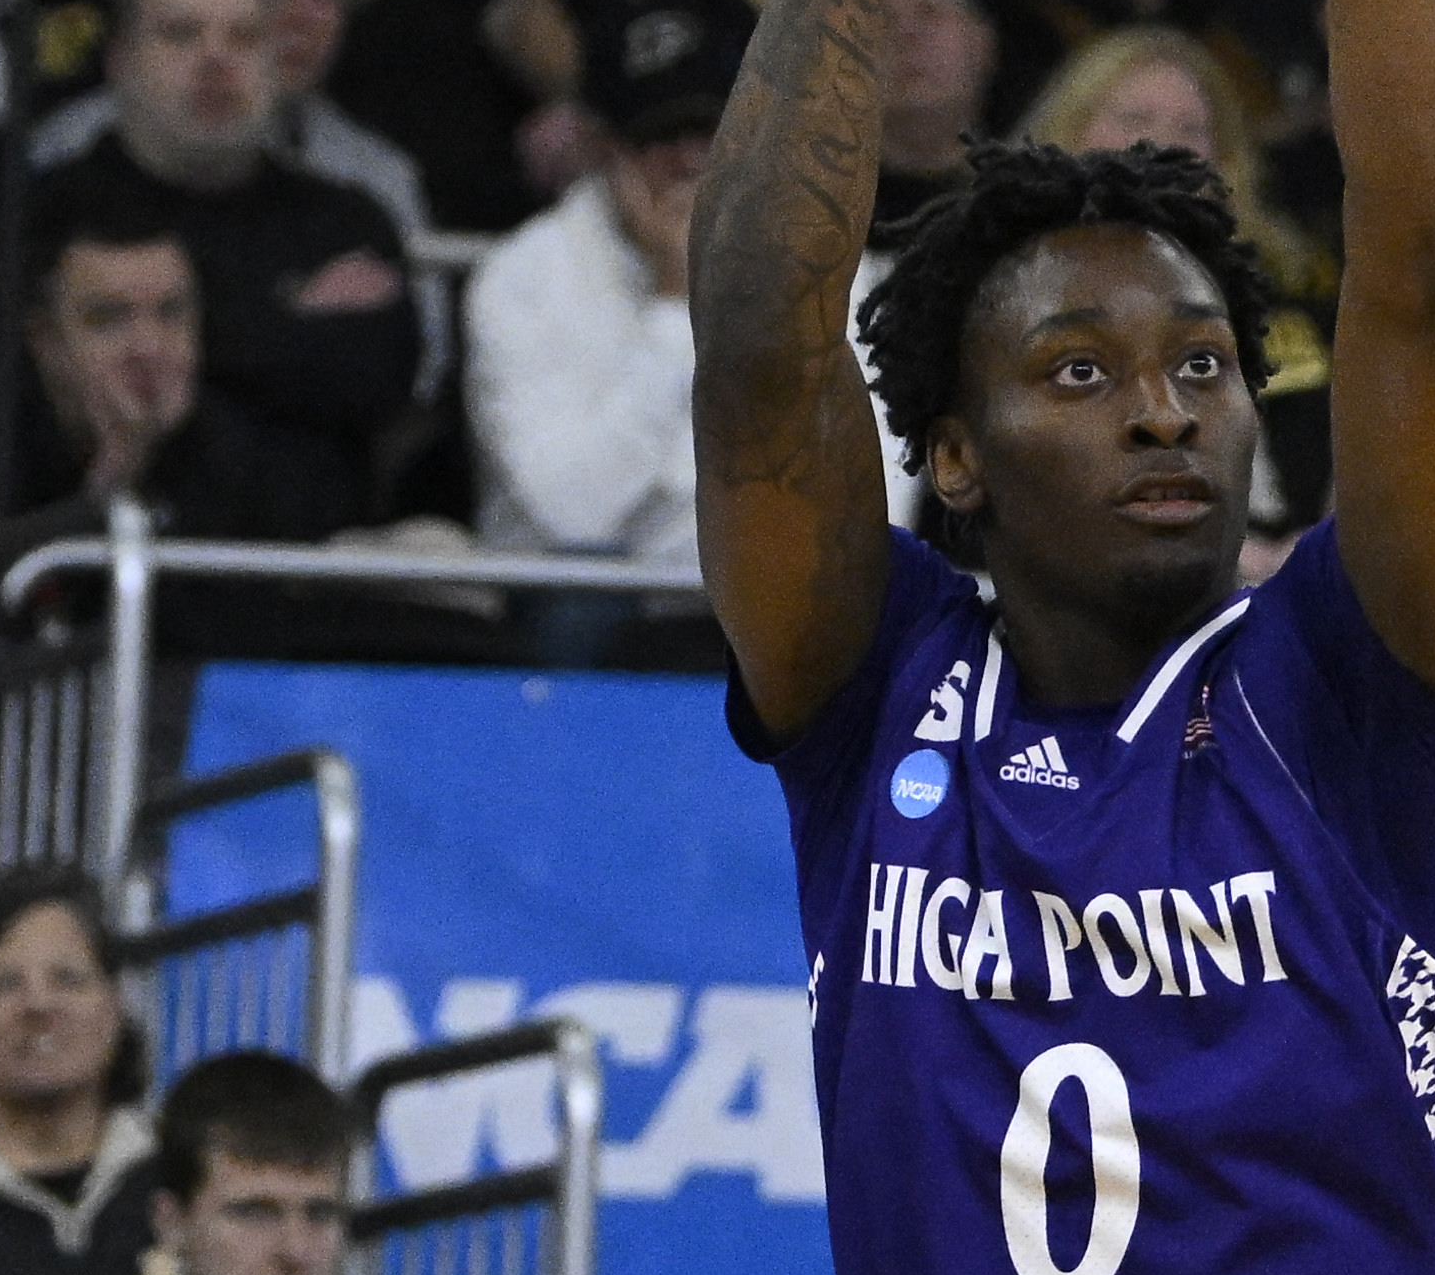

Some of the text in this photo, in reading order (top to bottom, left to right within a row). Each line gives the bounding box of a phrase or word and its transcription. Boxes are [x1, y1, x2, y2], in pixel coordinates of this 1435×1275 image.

[895, 778, 942, 804] NCAA
[999, 763, 1081, 791] adidas
[1031, 870, 1289, 1002] POINT
